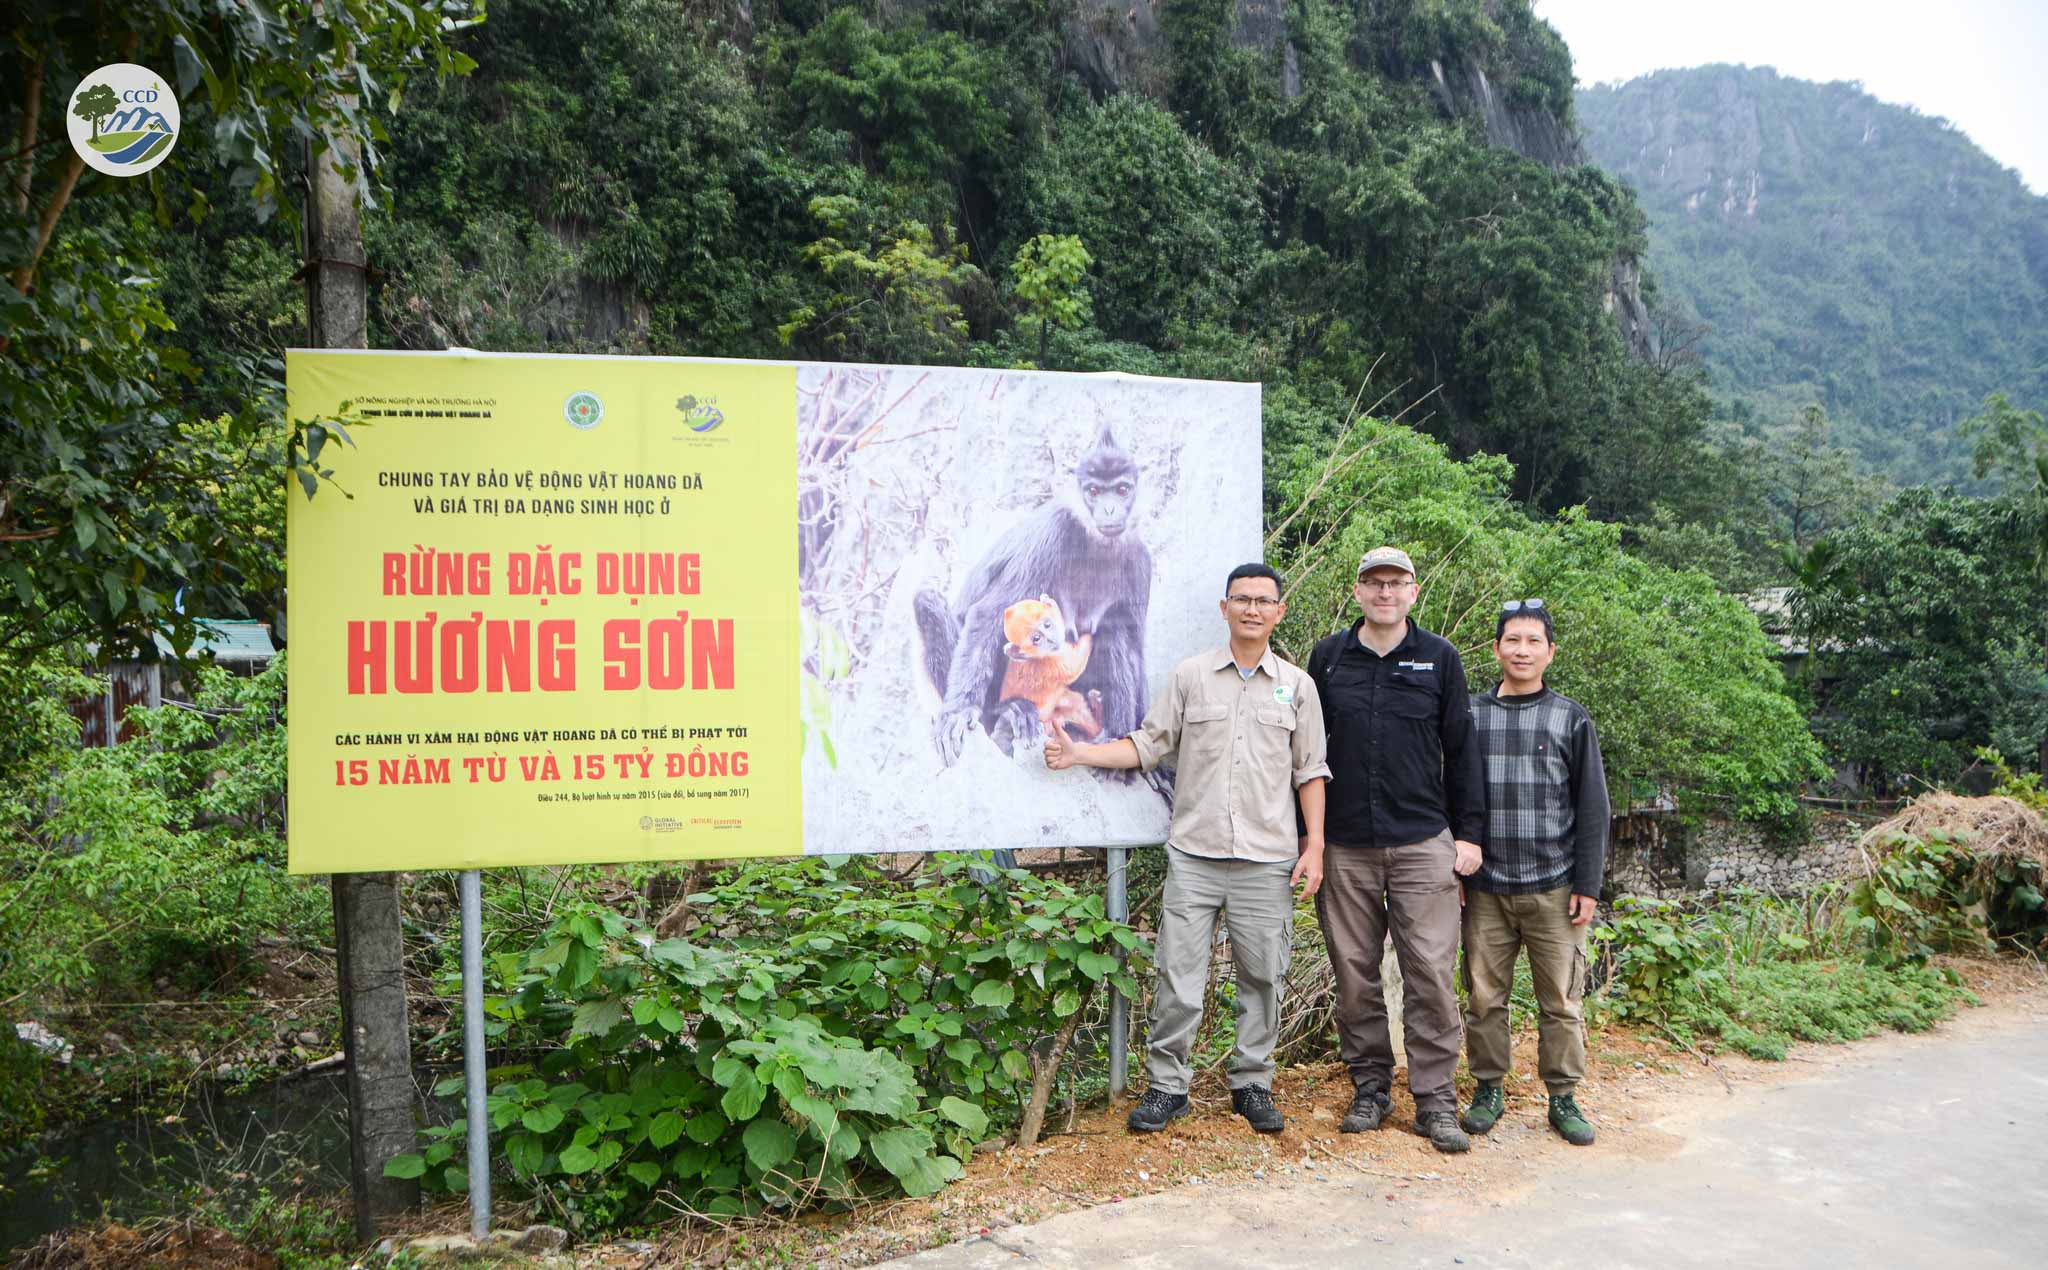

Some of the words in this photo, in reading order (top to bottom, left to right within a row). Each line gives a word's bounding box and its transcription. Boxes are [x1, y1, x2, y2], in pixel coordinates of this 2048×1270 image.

[378, 472, 433, 487] CHUNG
[440, 473, 470, 487] TAY
[477, 468, 508, 487] BẢO
[515, 470, 534, 491] VỆ
[540, 470, 583, 491] ĐỘNG
[588, 471, 618, 491] VẬT
[624, 474, 677, 489] HOANG
[683, 472, 703, 490] DÃ
[414, 496, 434, 513] VÀ
[440, 496, 467, 513] GIÁ
[473, 499, 498, 517] TRỊ
[504, 499, 526, 514] ĐA
[532, 499, 575, 517] DẠNG
[581, 500, 618, 514] SINH
[624, 500, 654, 518] HỌC
[661, 496, 670, 514] Ở
[383, 544, 491, 596] RỪNG
[506, 544, 582, 606] ĐẶC
[596, 552, 701, 606] DỤNG
[347, 611, 577, 695] HƯƠNG
[603, 610, 735, 691] SƠN
[407, 733, 420, 744] VI
[424, 731, 452, 744] XÂM
[457, 733, 479, 745] HẠI
[484, 730, 519, 744] ĐỘNG
[523, 729, 548, 744] VẬT
[553, 729, 595, 742] HOANG
[641, 725, 667, 740] THỂ
[672, 728, 684, 741] BỊ
[689, 728, 722, 741] PHẠT
[727, 726, 747, 738] TỚI
[335, 760, 369, 786] 15
[378, 754, 451, 785] NĂM
[463, 752, 507, 783] TÙ
[519, 750, 561, 781] VÀ
[573, 755, 606, 781] 15
[613, 746, 654, 779] TỶ
[665, 743, 749, 778] ĐỒNG
[555, 793, 570, 802] 244,
[638, 790, 656, 799] 2015
[697, 790, 712, 799] sung
[729, 788, 749, 798] 2017)
